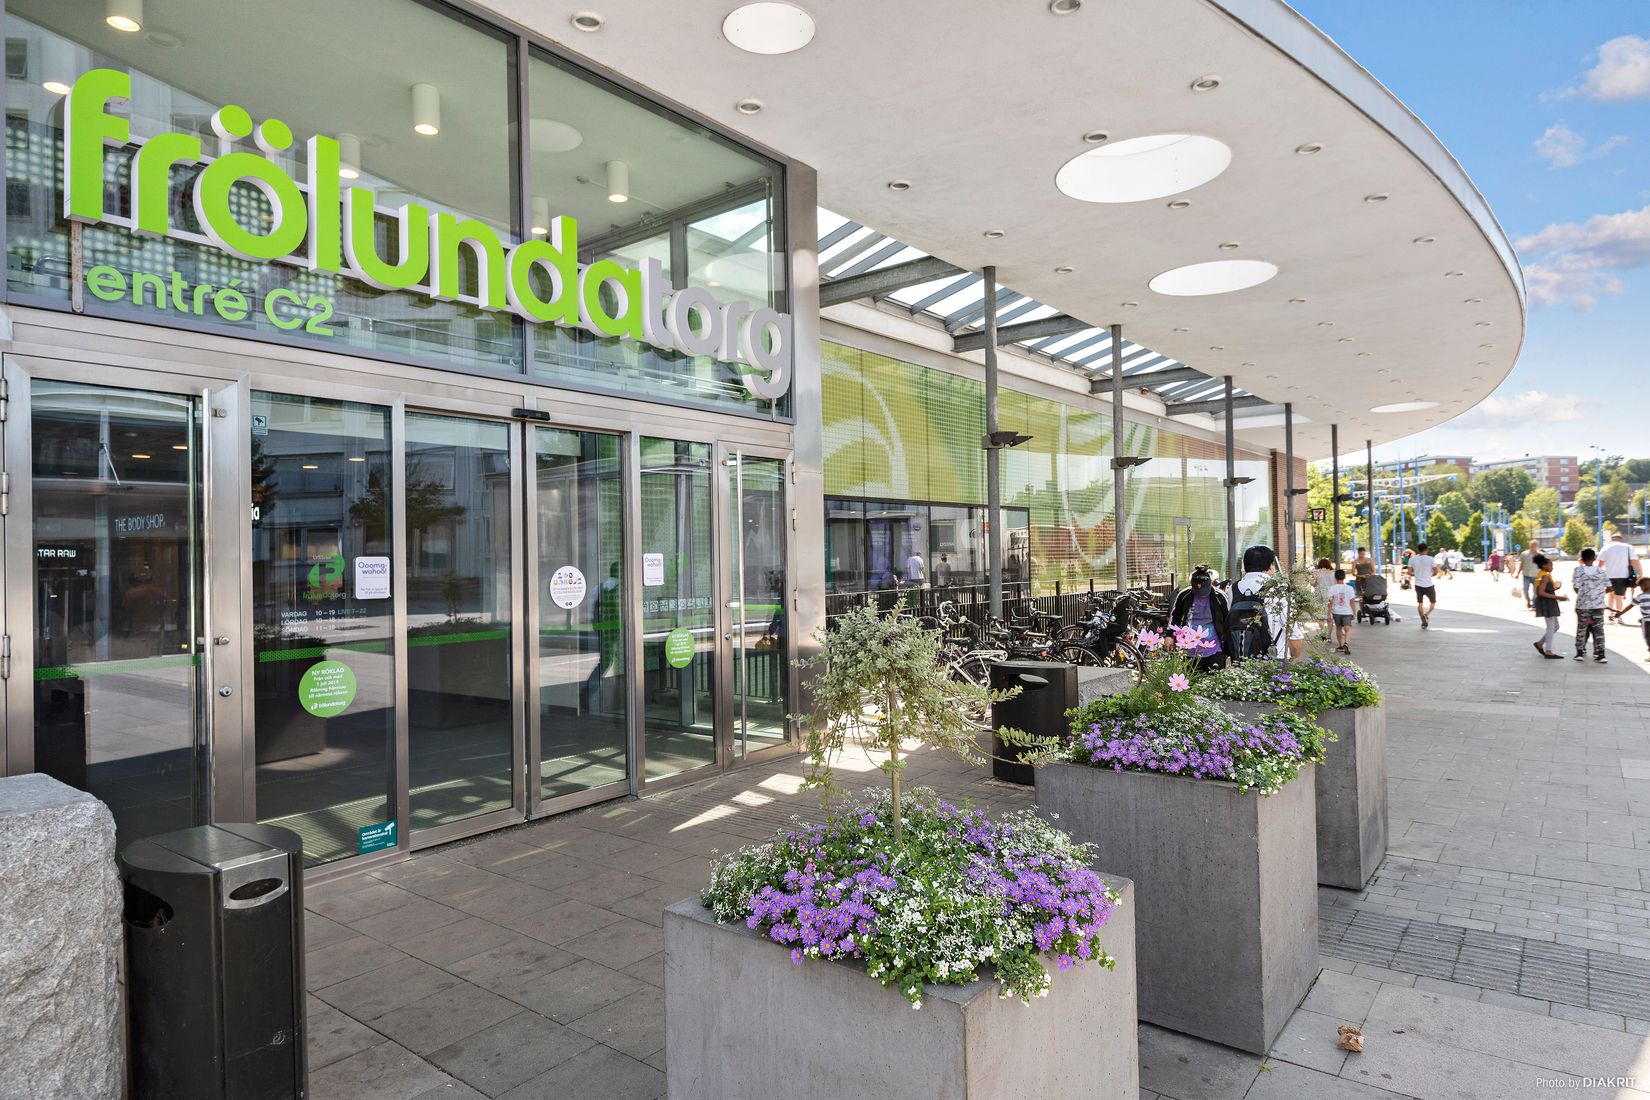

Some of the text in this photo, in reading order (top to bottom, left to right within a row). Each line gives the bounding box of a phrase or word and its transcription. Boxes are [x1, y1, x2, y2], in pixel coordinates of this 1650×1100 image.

[64, 68, 792, 400] frölundatorg
[87, 265, 334, 337] entré C2
[115, 519, 127, 532] THE
[128, 516, 146, 531] BODY
[57, 549, 76, 558] RAW
